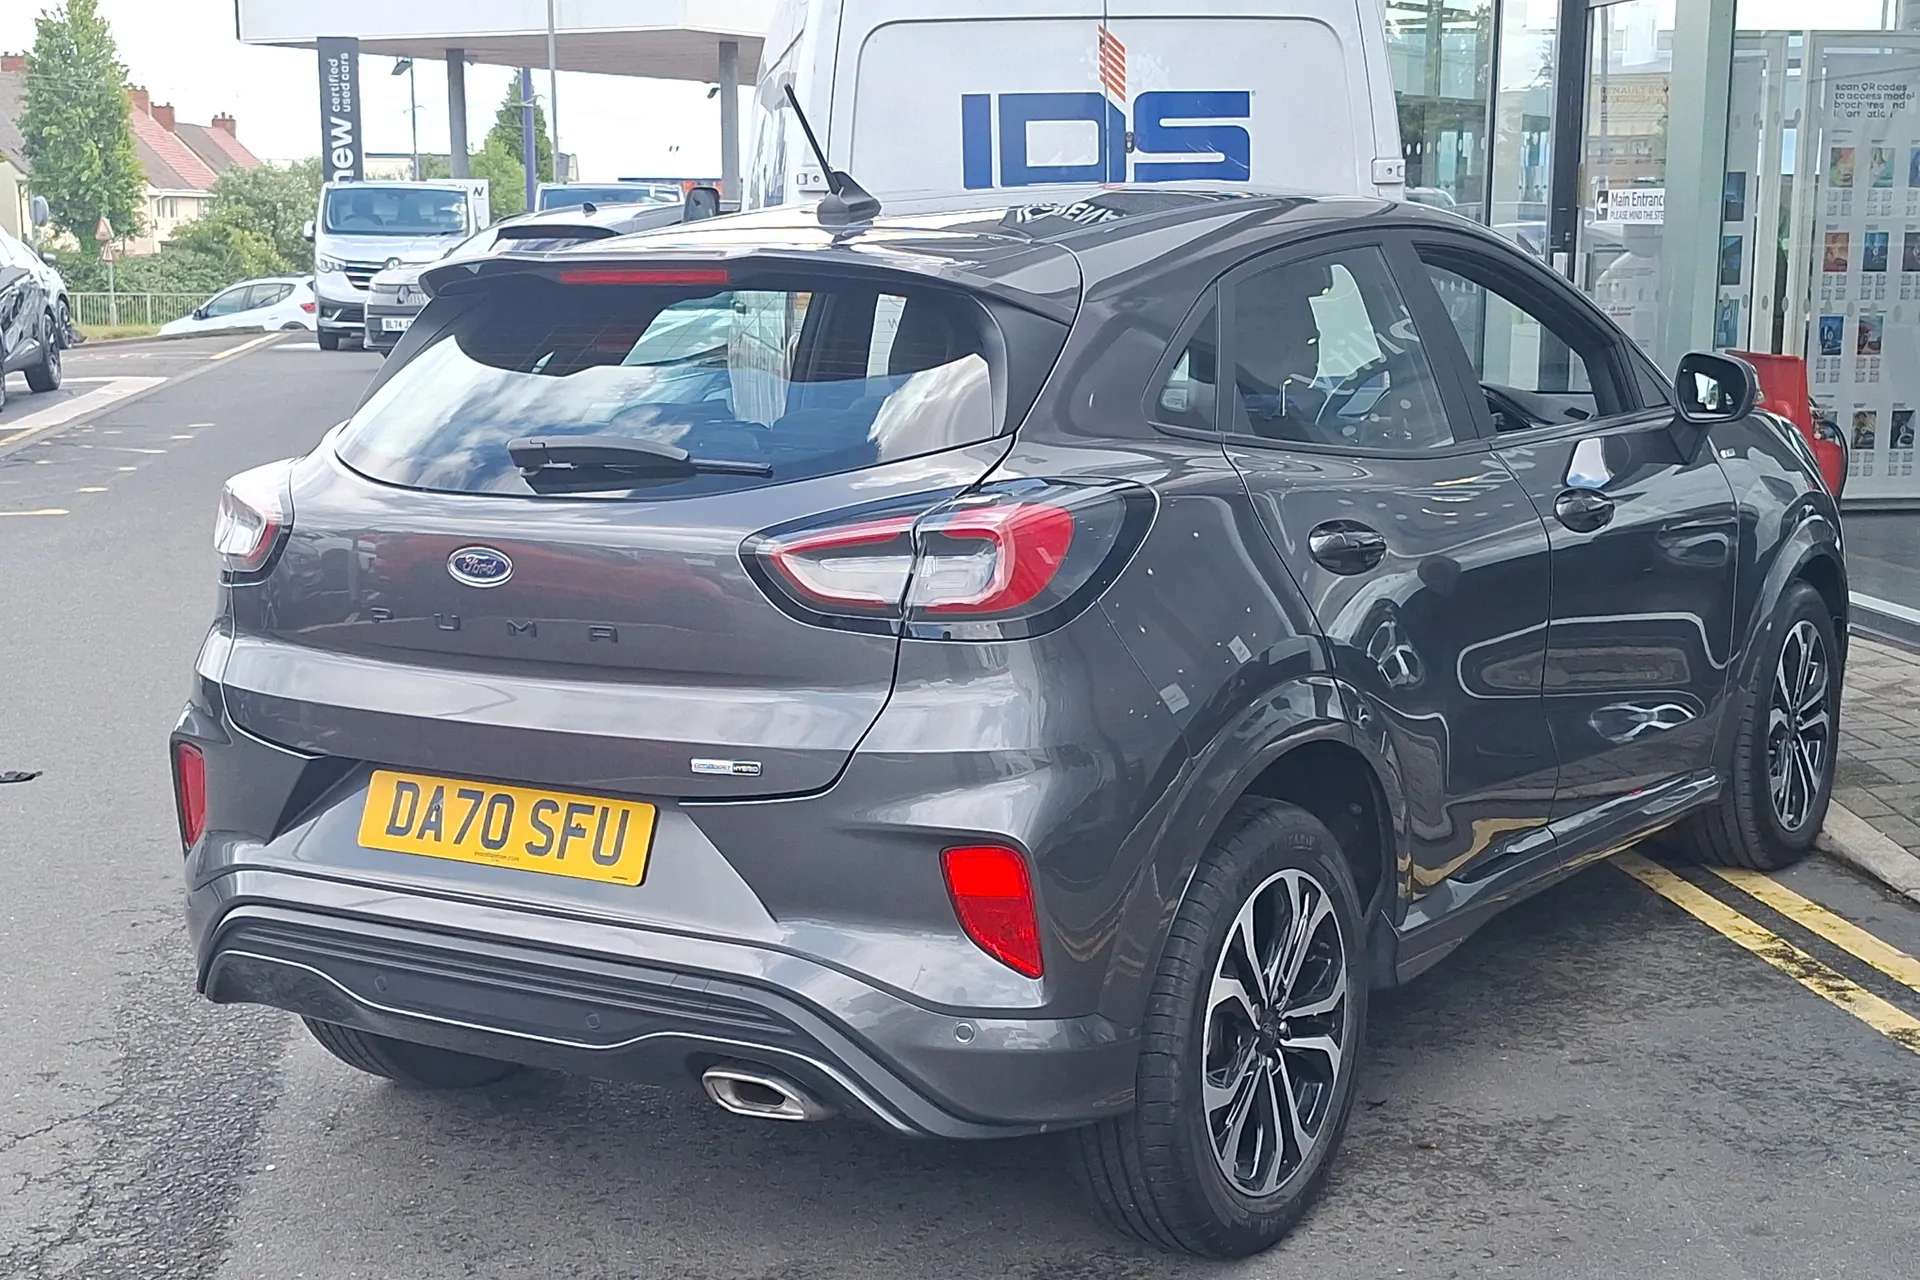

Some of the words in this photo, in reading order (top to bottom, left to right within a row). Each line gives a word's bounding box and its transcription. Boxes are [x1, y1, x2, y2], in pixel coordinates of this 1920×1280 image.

[340, 52, 350, 80] cars
[328, 58, 340, 112] certified
[340, 83, 351, 112] used
[1835, 92, 1845, 100] to
[1861, 82, 1875, 91] QR
[1877, 83, 1907, 91] codes
[961, 90, 1251, 190] IDS
[1611, 191, 1630, 207] Main
[1631, 191, 1663, 207] Entranc
[463, 553, 496, 576] Ford
[371, 607, 618, 643] PUMA
[385, 780, 515, 850] DA70
[525, 798, 630, 866] SFU
